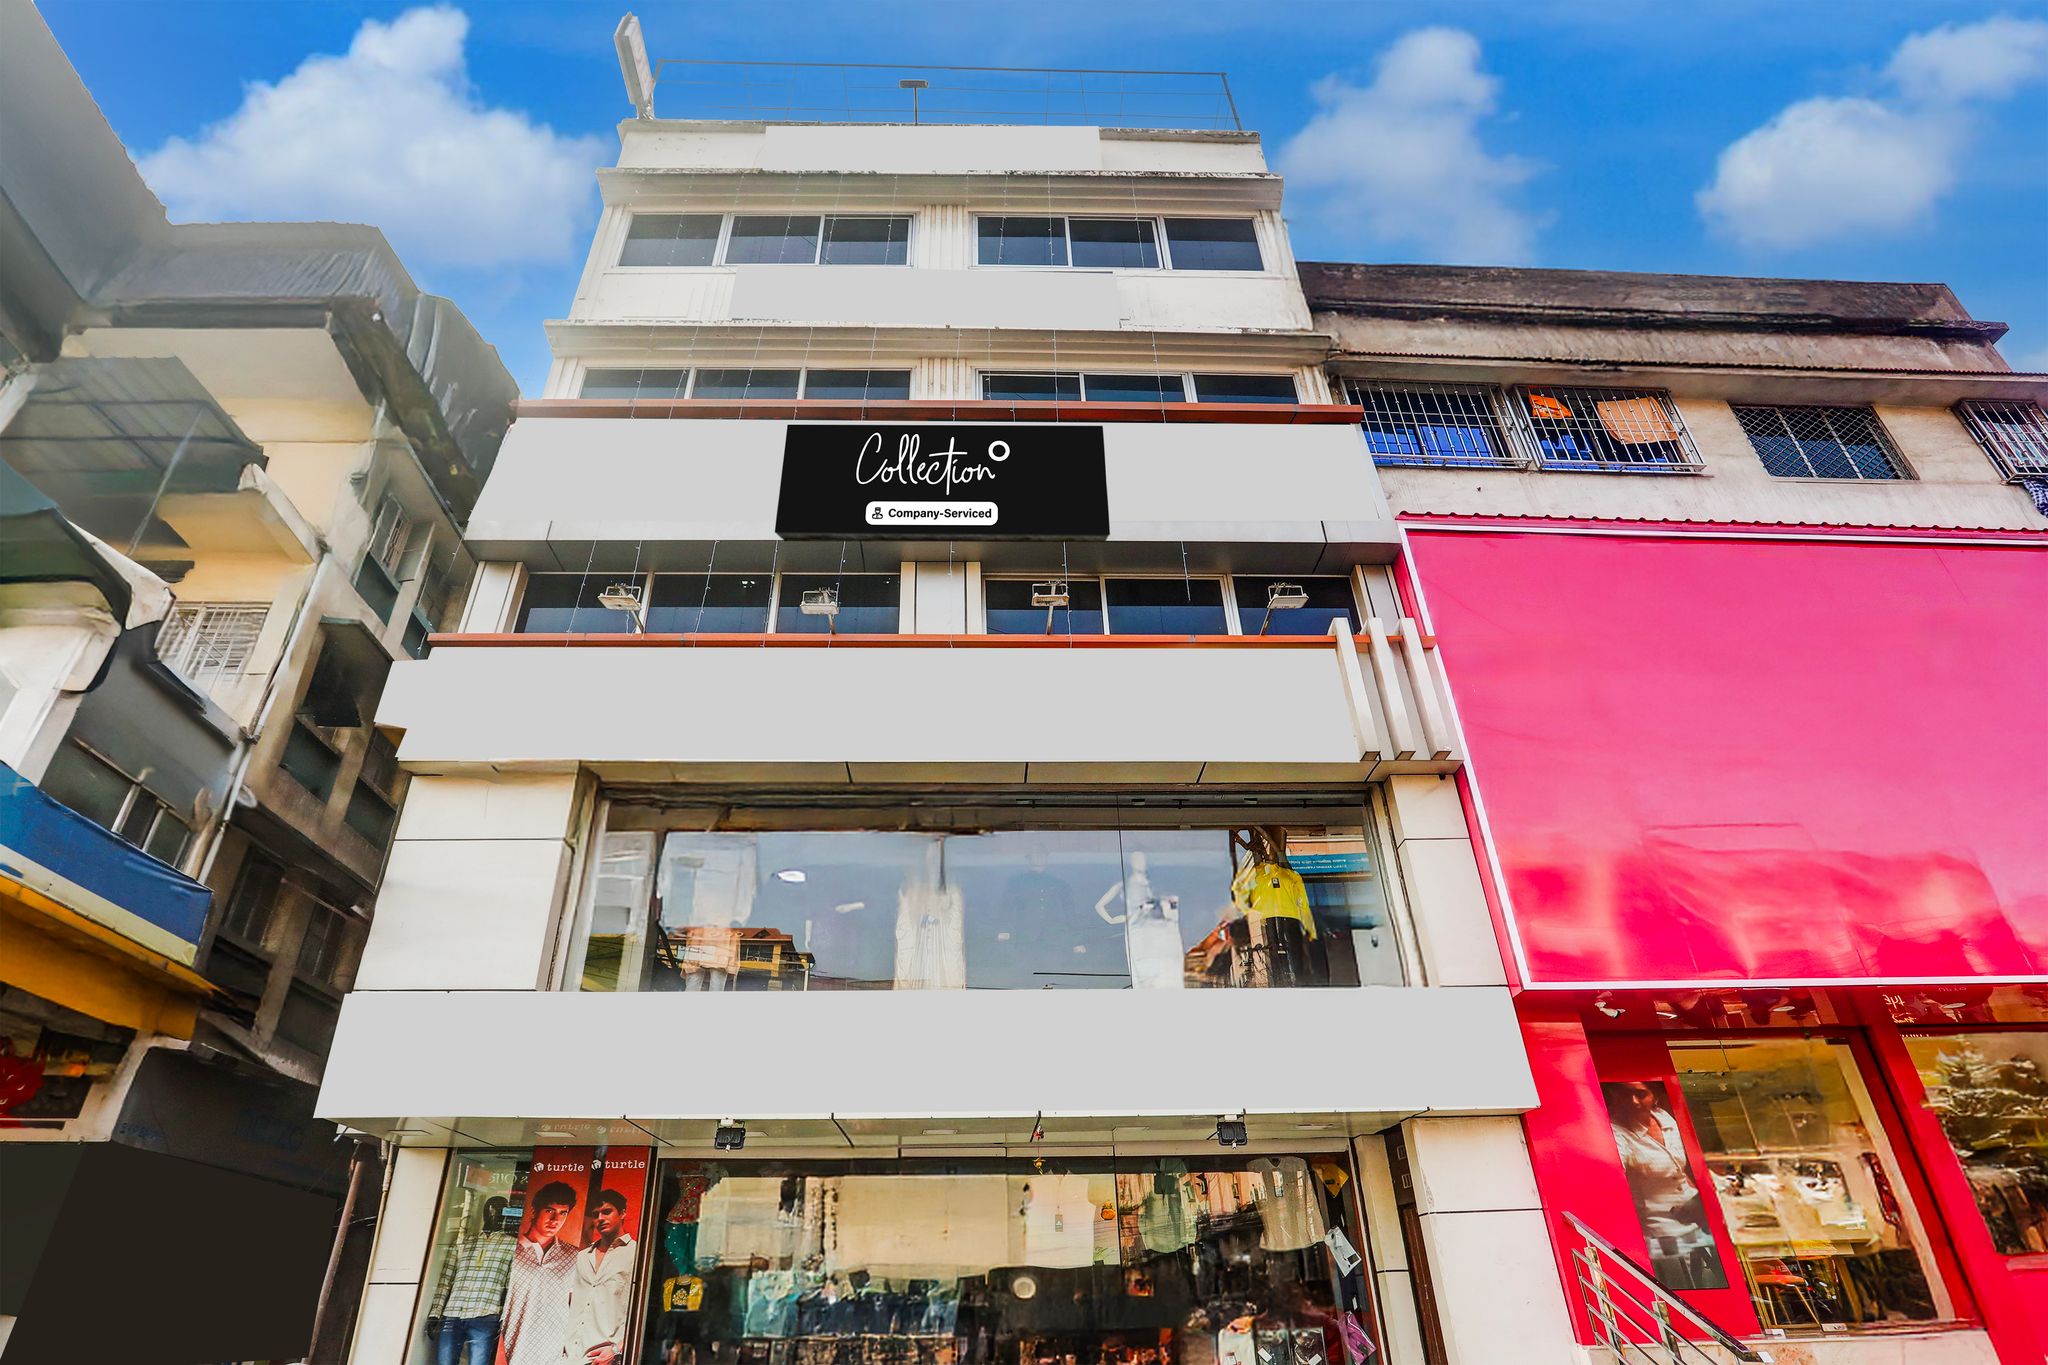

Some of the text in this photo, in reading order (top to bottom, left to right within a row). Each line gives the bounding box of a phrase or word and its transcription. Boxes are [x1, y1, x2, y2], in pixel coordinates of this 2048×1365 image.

[856, 432, 996, 496] Collection
[888, 507, 992, 521] Company-Serviced
[547, 1163, 585, 1172] turtle
[604, 1159, 646, 1169] turtle
